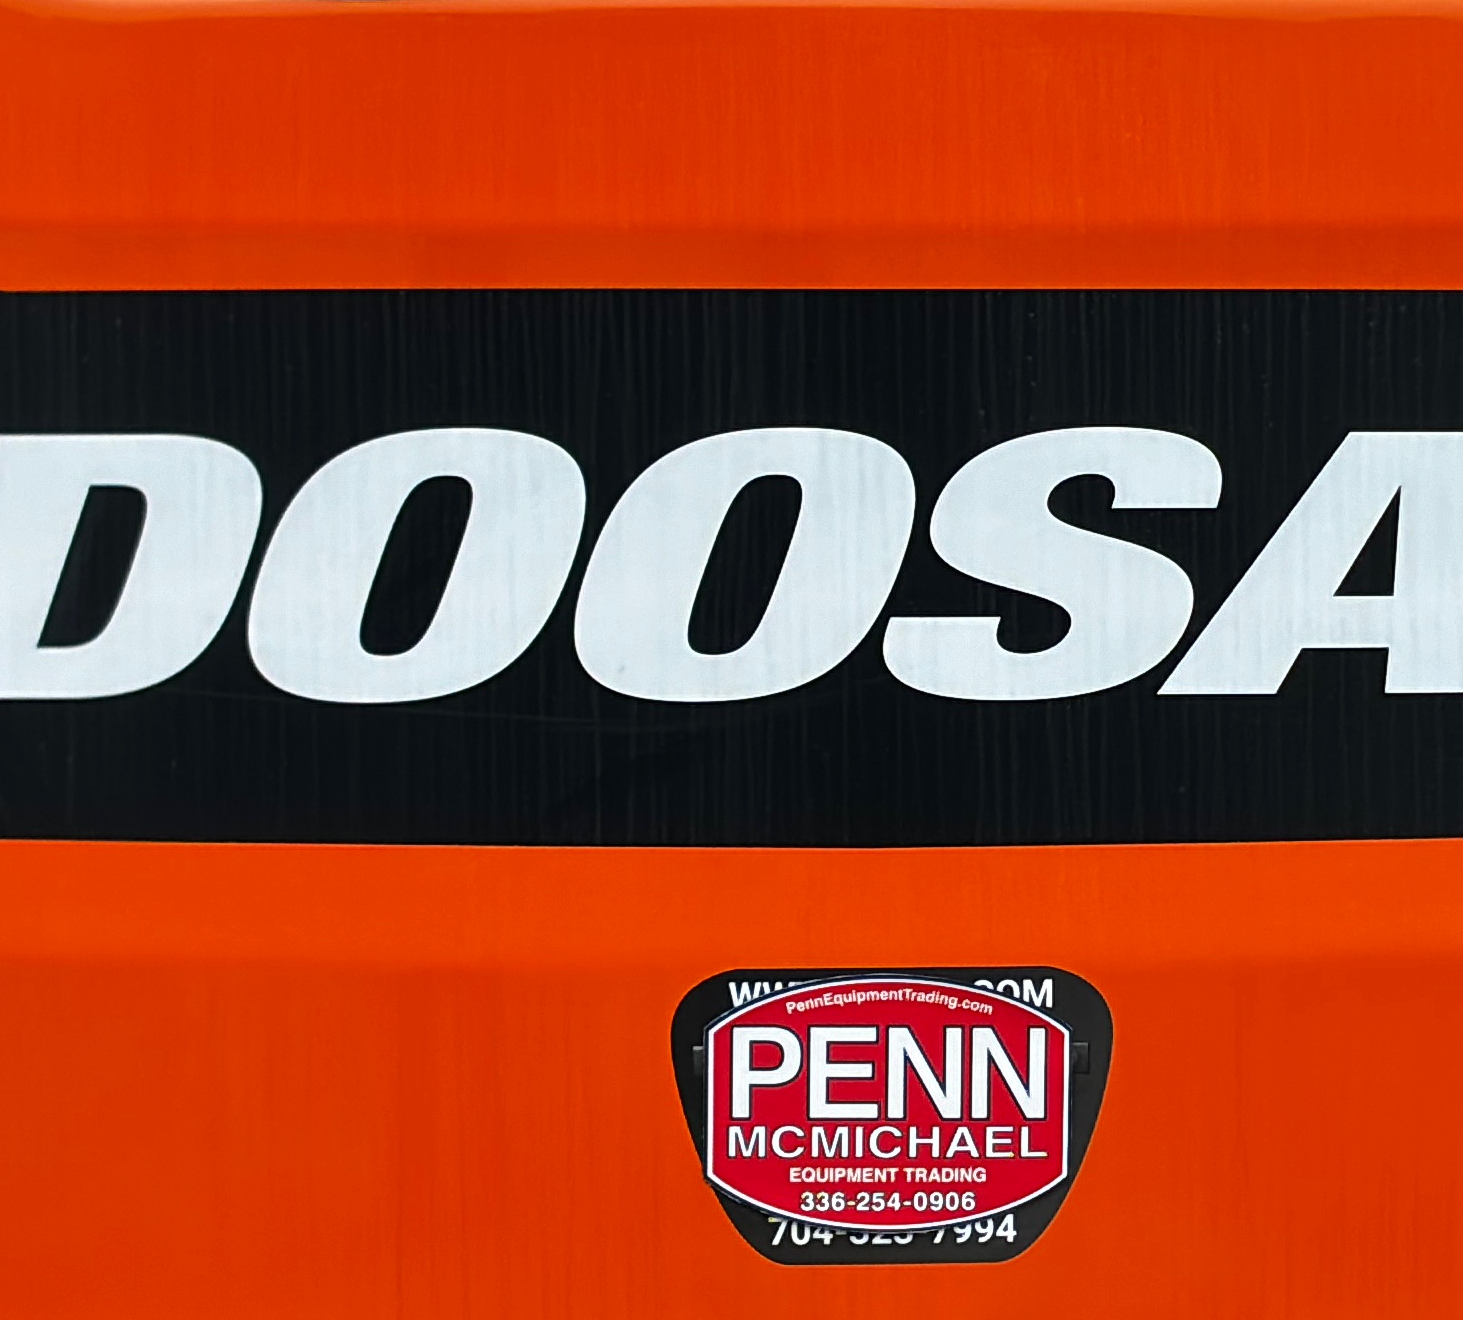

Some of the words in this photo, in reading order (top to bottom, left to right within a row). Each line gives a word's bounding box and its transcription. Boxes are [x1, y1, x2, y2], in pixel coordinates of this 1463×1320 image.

[786, 988, 994, 1015] PennEquipmentTrading.com
[731, 1026, 1046, 1119] PENN
[728, 1126, 1048, 1159] MCMICHAEL
[789, 1166, 899, 1183] EQUIPMENT
[903, 1166, 987, 1183] TRADING
[800, 1191, 976, 1212] 336-254-0906
